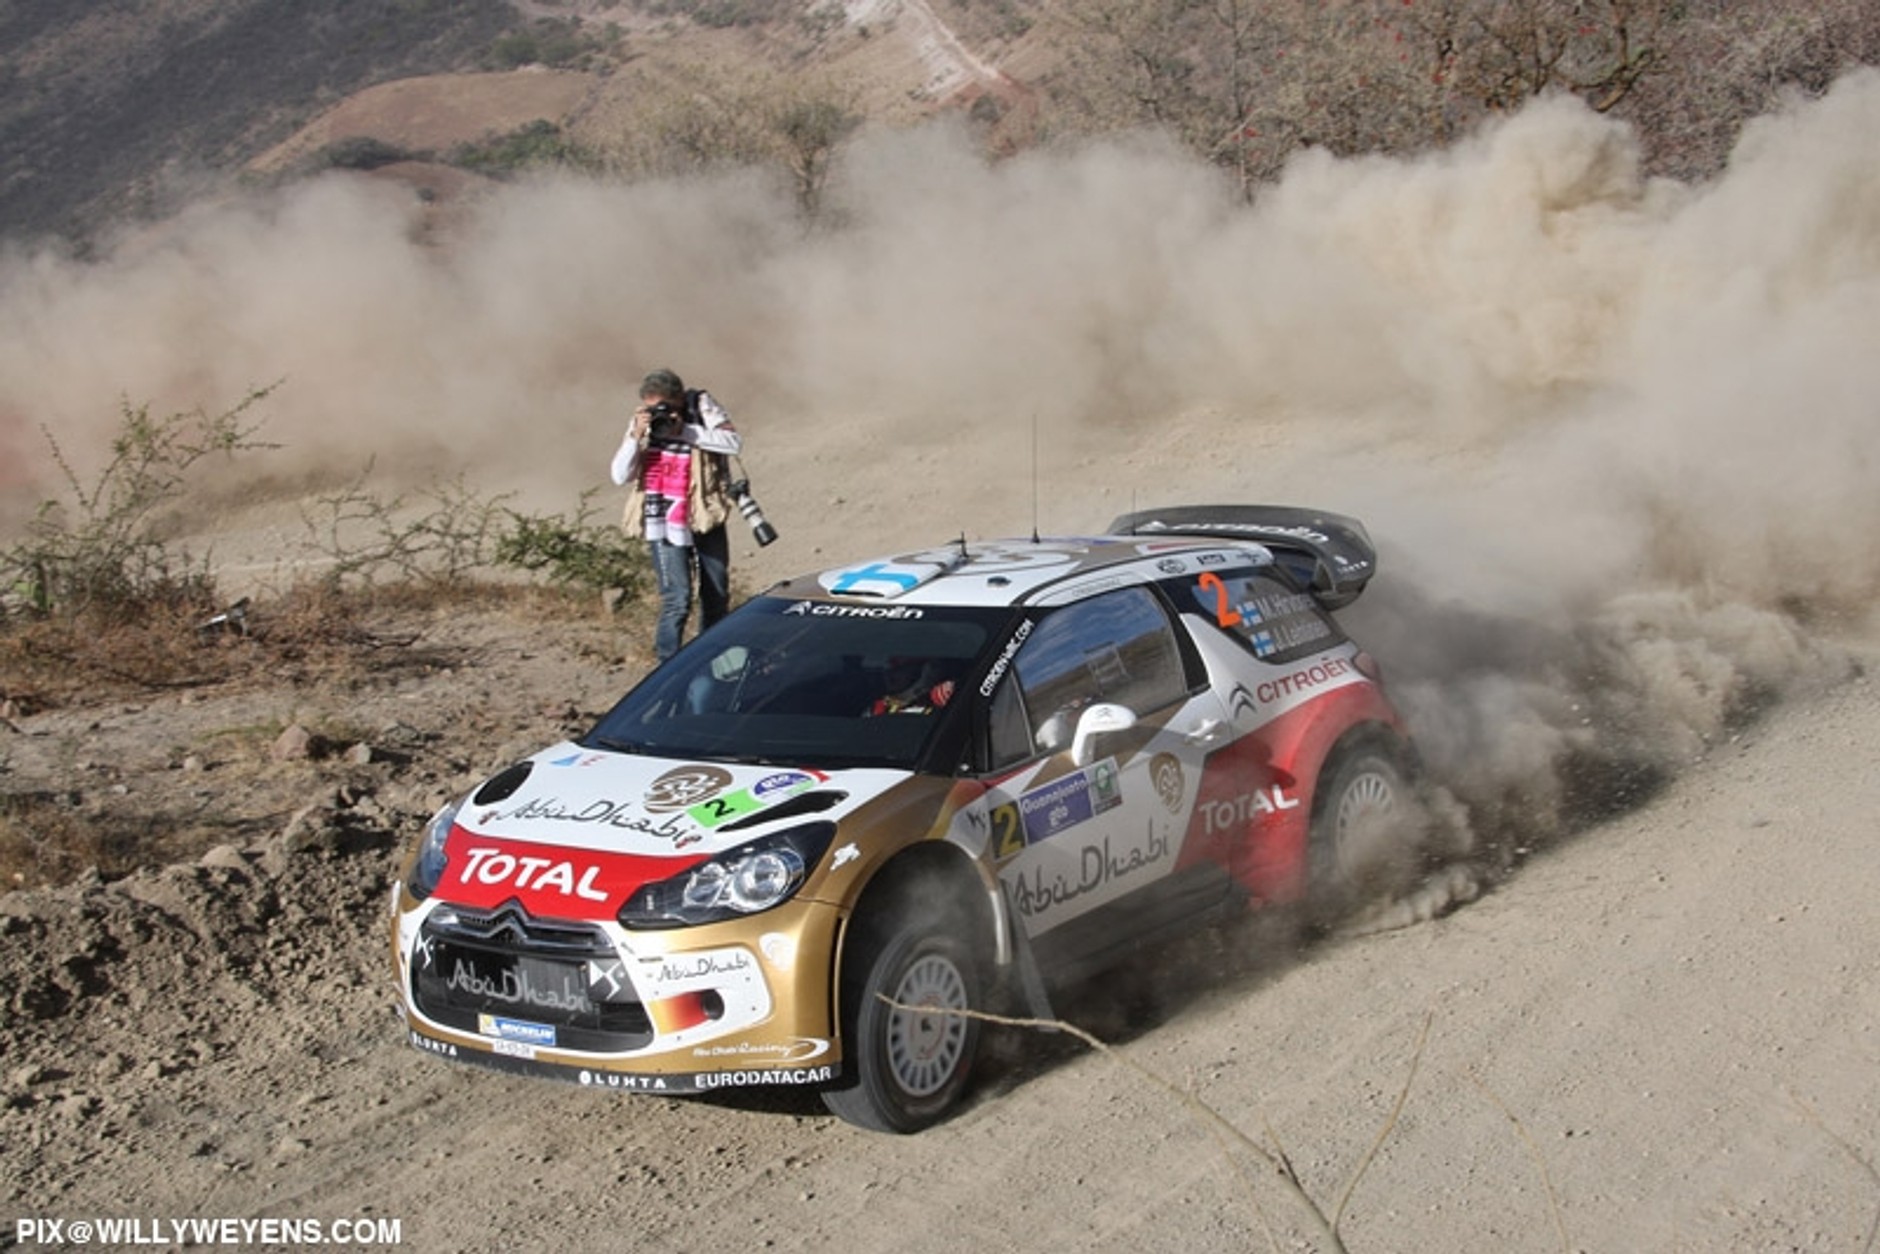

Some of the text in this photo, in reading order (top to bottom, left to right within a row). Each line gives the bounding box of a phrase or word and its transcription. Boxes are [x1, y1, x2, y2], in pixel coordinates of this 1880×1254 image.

[1199, 572, 1242, 628] 2
[704, 798, 736, 818] 2
[994, 804, 1024, 856] 2
[1198, 783, 1299, 834] TOTAL
[460, 848, 608, 901] TOTAL
[594, 1073, 666, 1089] LUHTA
[695, 1066, 832, 1088] EURODATACAR
